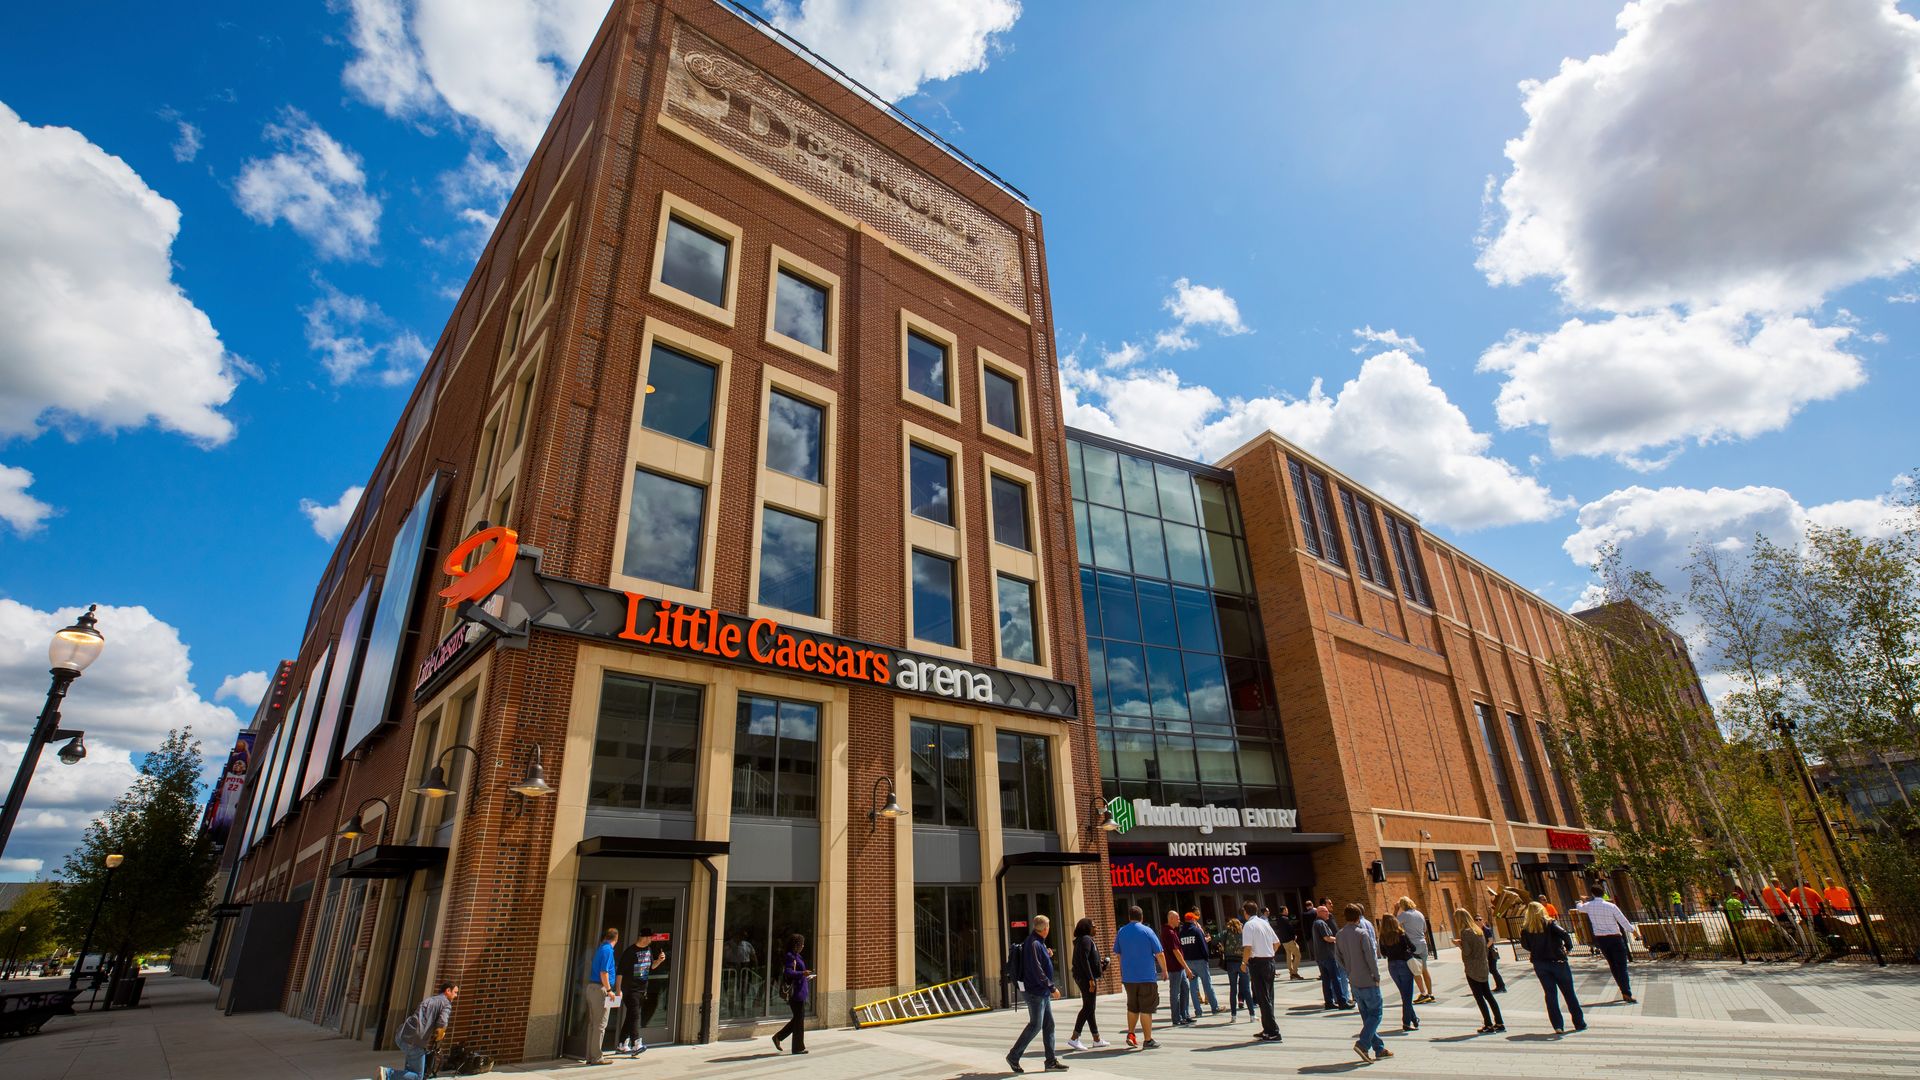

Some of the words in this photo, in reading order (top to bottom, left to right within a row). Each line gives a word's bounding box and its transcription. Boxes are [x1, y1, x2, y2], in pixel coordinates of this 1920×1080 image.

[618, 591, 741, 659] Little
[748, 618, 891, 684] Caesars
[896, 658, 993, 702] arena
[1133, 798, 1240, 834] Huntington
[1241, 808, 1297, 828] ENTRY
[1168, 842, 1247, 857] NORTHWEST
[1110, 863, 1145, 887] ittle
[1146, 861, 1210, 886] Caesars
[1212, 866, 1261, 885] arena
[1180, 936, 1196, 946] STAFF
